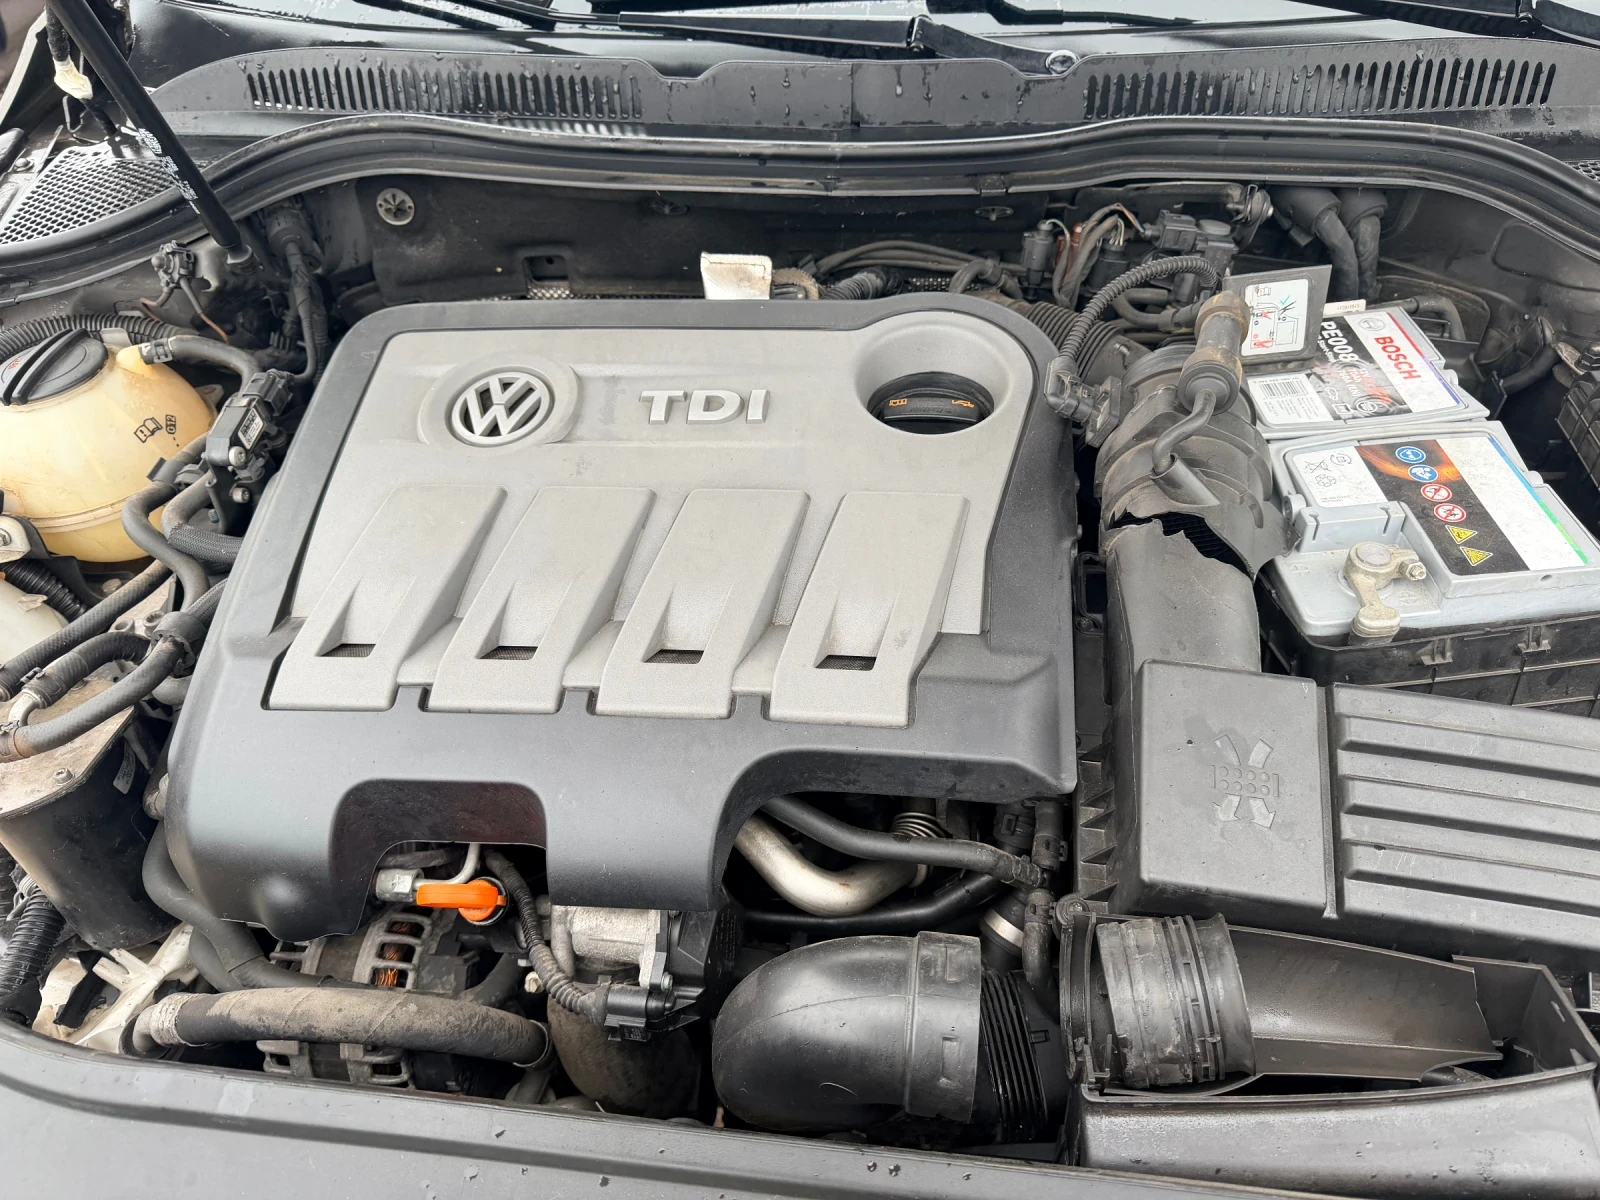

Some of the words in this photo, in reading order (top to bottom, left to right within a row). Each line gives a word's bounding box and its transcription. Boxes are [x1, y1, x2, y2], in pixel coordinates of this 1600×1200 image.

[1320, 320, 1360, 362] PE008
[1374, 336, 1422, 380] BOSCH
[166, 415, 176, 434] G12
[453, 372, 550, 444] VW
[640, 389, 770, 425] TDI
